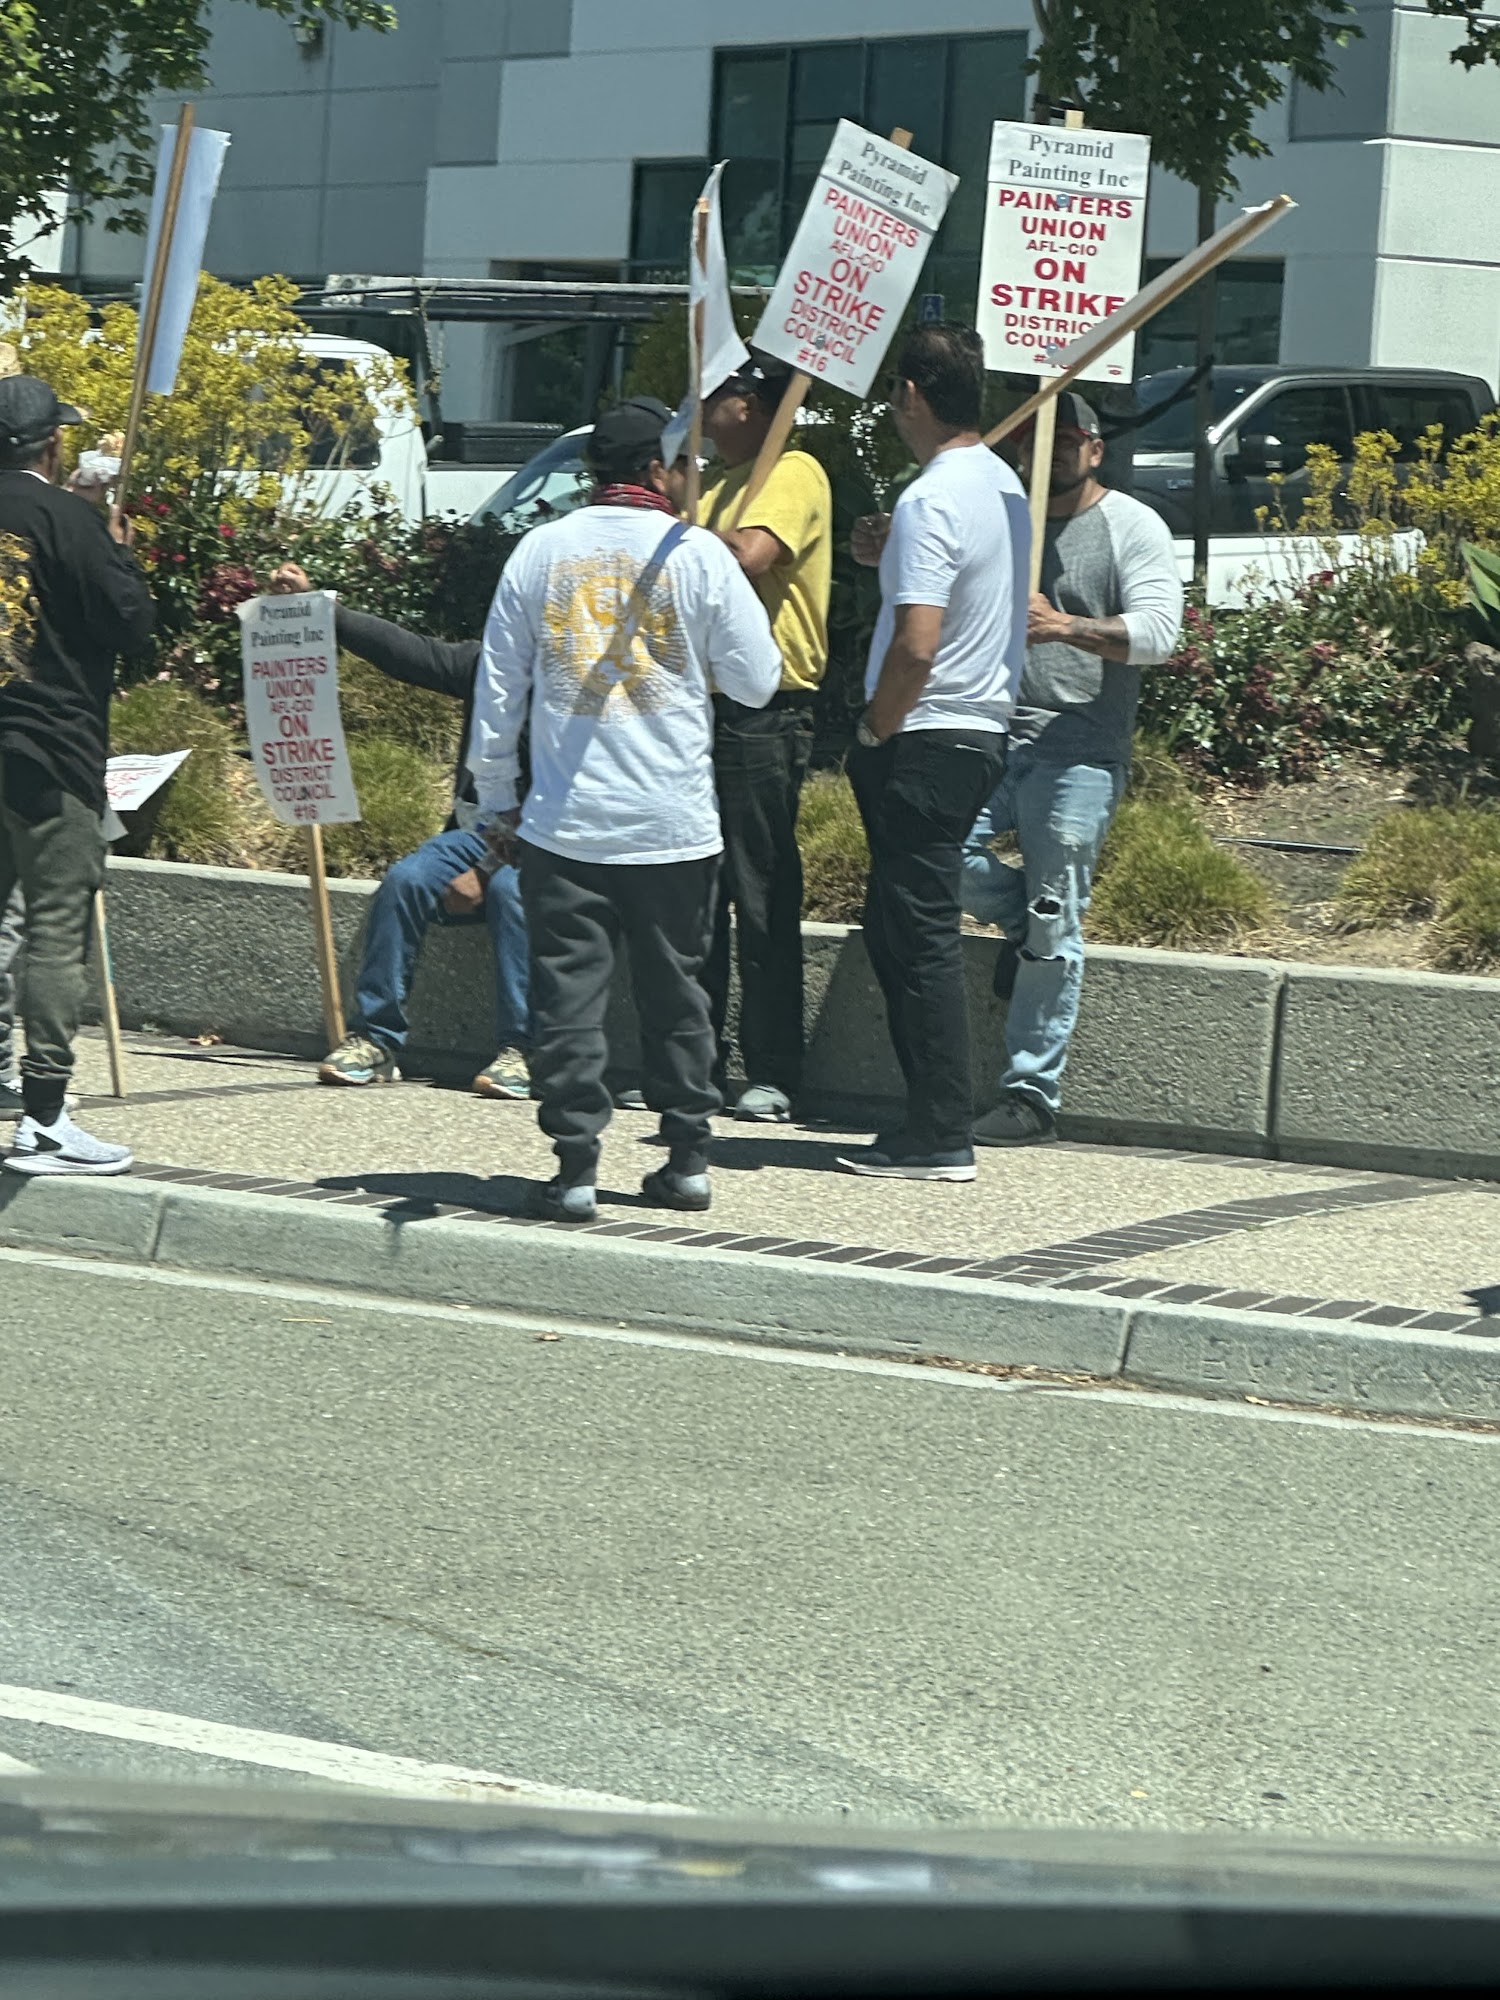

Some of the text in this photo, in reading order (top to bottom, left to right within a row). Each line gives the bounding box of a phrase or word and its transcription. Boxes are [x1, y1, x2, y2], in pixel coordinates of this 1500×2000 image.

[1029, 134, 1114, 160] Pyramid
[861, 141, 929, 186] Pyramid
[1008, 159, 1130, 188] Painting Inc
[837, 160, 931, 216] Painting Inc
[998, 189, 1133, 219] PAINTERS
[823, 187, 920, 248] PAINTERS
[1021, 216, 1107, 241] UNION
[833, 216, 897, 261] UNION
[1025, 240, 1098, 256] AFL-CIO
[829, 240, 885, 273] AFL-CIO
[830, 259, 870, 293] ON
[1033, 257, 1087, 284] ON
[794, 271, 886, 332] STRIKE
[791, 299, 869, 347] DISTRICT
[1004, 313, 1100, 336] DISTRIC
[797, 349, 828, 372] #16
[259, 601, 312, 625] Pyramid
[251, 627, 324, 648] Painting Inc
[252, 656, 328, 680] PAINTERS
[266, 679, 315, 699] UNION
[279, 715, 310, 738] ON
[262, 738, 336, 765] STRIKE
[270, 765, 332, 784] DISTRICT
[273, 785, 336, 802] COUNCIL
[294, 804, 319, 821] #16
